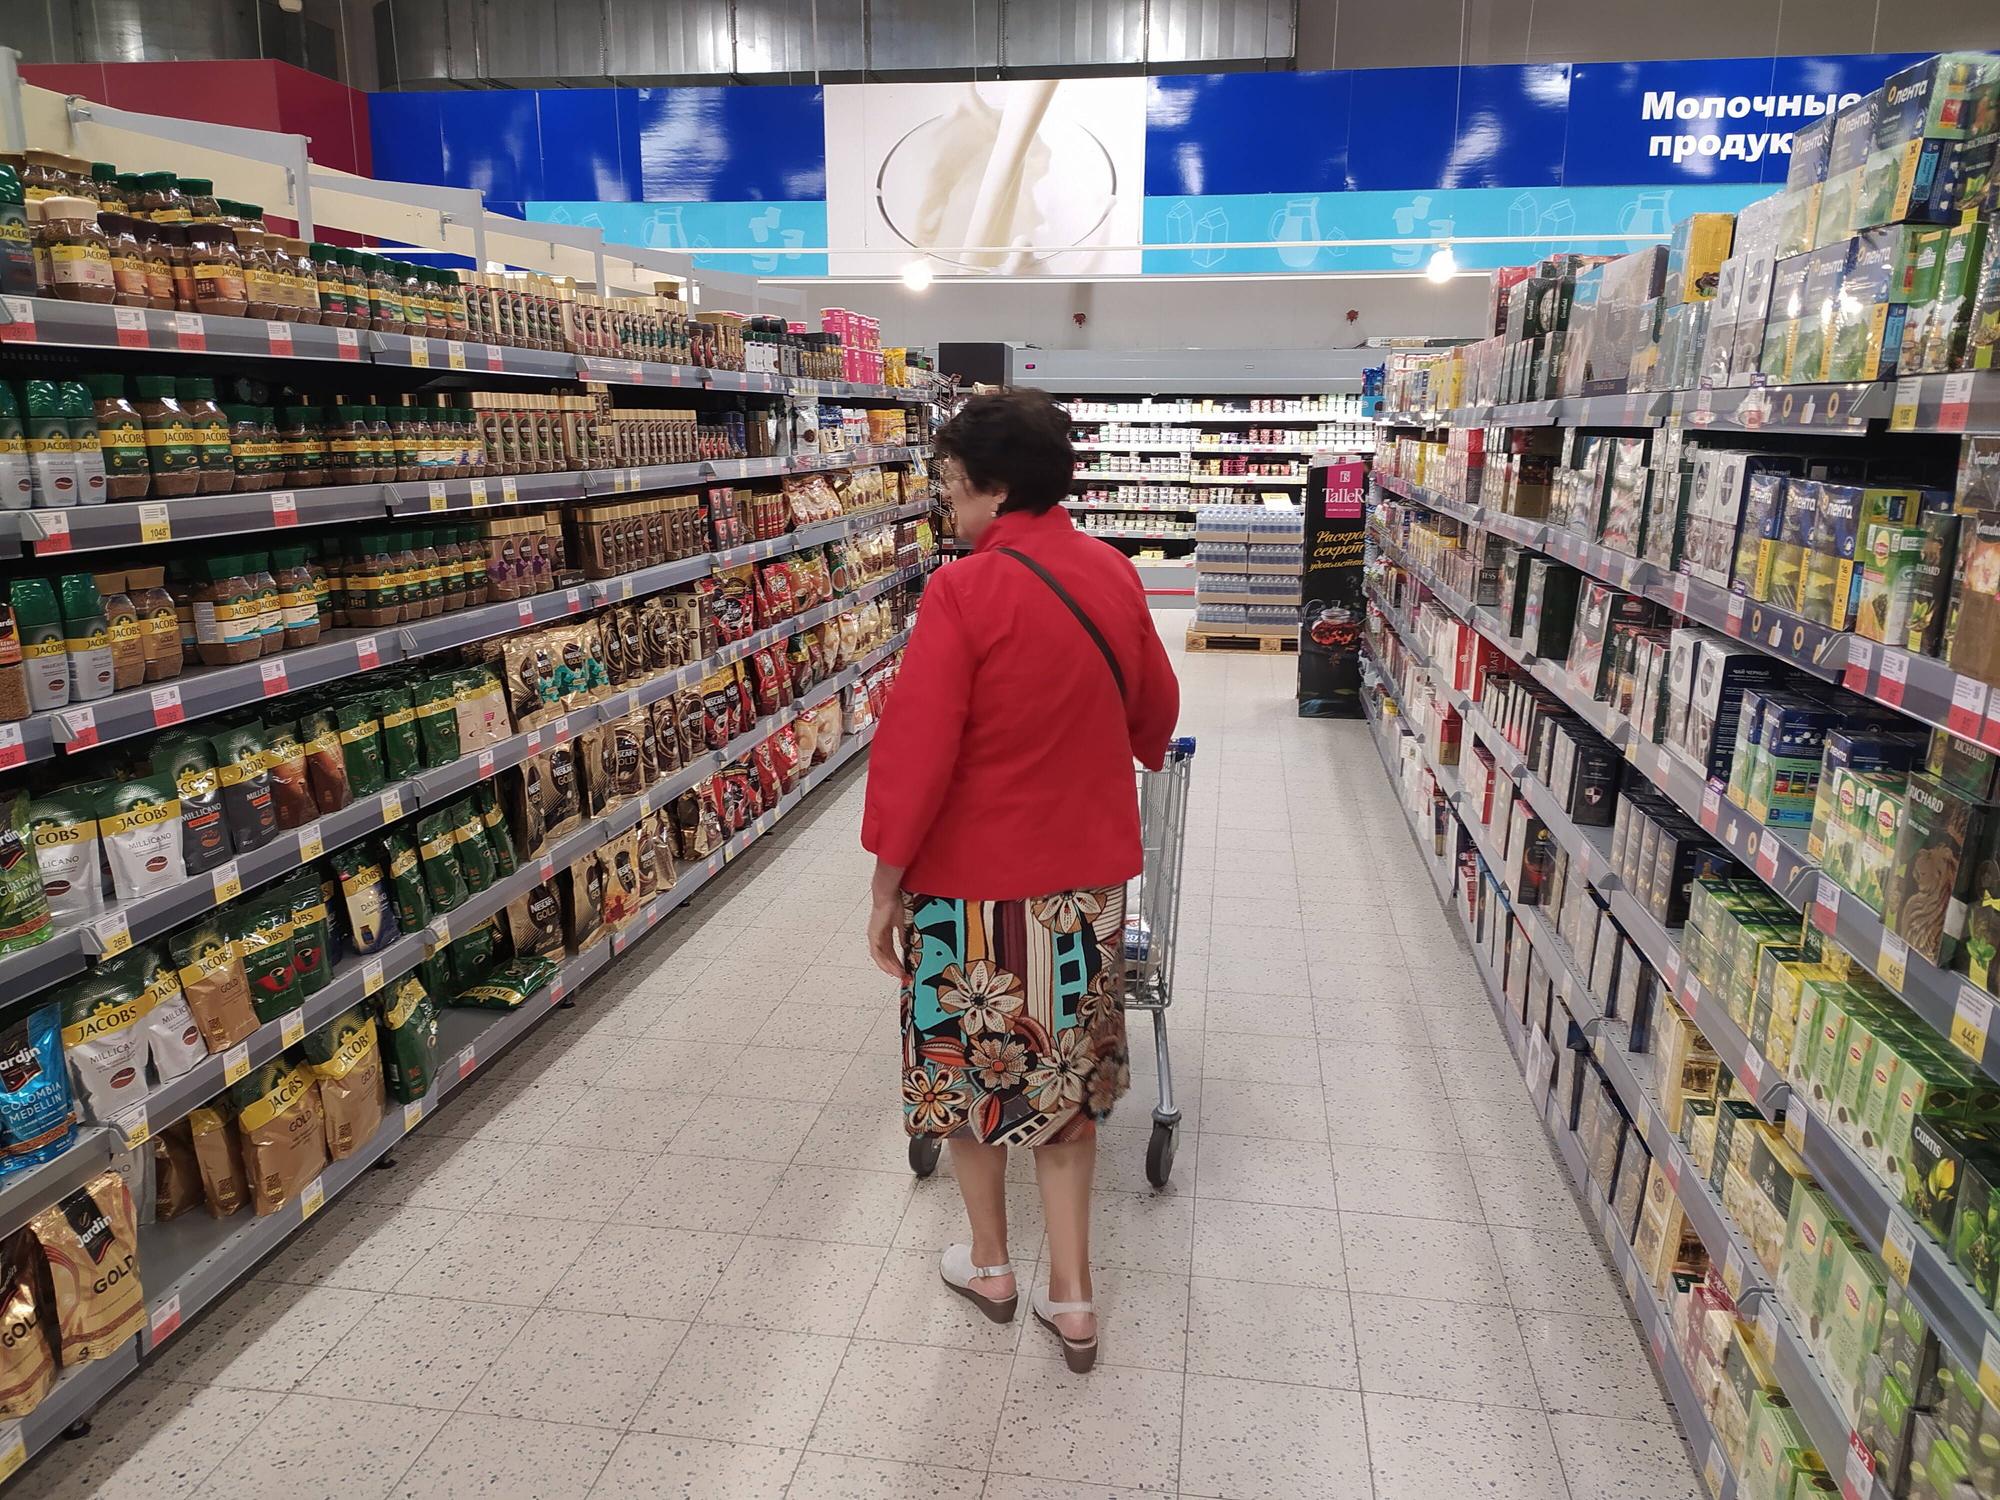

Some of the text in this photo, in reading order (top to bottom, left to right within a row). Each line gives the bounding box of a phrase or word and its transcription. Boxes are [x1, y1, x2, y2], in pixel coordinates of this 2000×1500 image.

[1649, 131, 1793, 164] продук
[112, 434, 146, 445] JACOBS
[164, 432, 194, 442] JACOBS
[202, 432, 229, 442] JACOBS
[1322, 487, 1365, 504] TalleR
[1827, 502, 1853, 519] лента
[1316, 530, 1365, 545] Раскро
[1313, 542, 1364, 560] секрет
[377, 577, 398, 587] JACOBS
[294, 591, 317, 605] JACOBS
[229, 605, 257, 618] JACOBS
[111, 627, 141, 639] JACOBS
[150, 618, 178, 632] JACOBS
[35, 644, 65, 656] JACOBS
[1953, 738, 1988, 763] RICHARD
[181, 776, 215, 794] COBS
[1910, 785, 1944, 813] RICHARD
[120, 807, 168, 830] JACOBS
[0, 830, 20, 845] rdin
[35, 829, 79, 845] COBS
[128, 833, 171, 849] MILLICANO
[41, 855, 79, 869] LICANO
[293, 911, 313, 926] OBS
[536, 905, 556, 921] GOLD
[152, 974, 181, 1003] JACOB
[220, 979, 239, 994] GOLD
[78, 1006, 137, 1042] JACOBS
[340, 1033, 369, 1066] JACOBS
[0, 1047, 41, 1070] ardin
[1, 1083, 61, 1115] COLOMBIA
[9, 1094, 62, 1124] MEDELLIN
[288, 1109, 313, 1132] GOLD
[1914, 1126, 1942, 1158] CURTIS
[77, 1214, 113, 1248] Jardin
[93, 1254, 134, 1295] GOLD
[2, 1306, 39, 1349] GOLD
